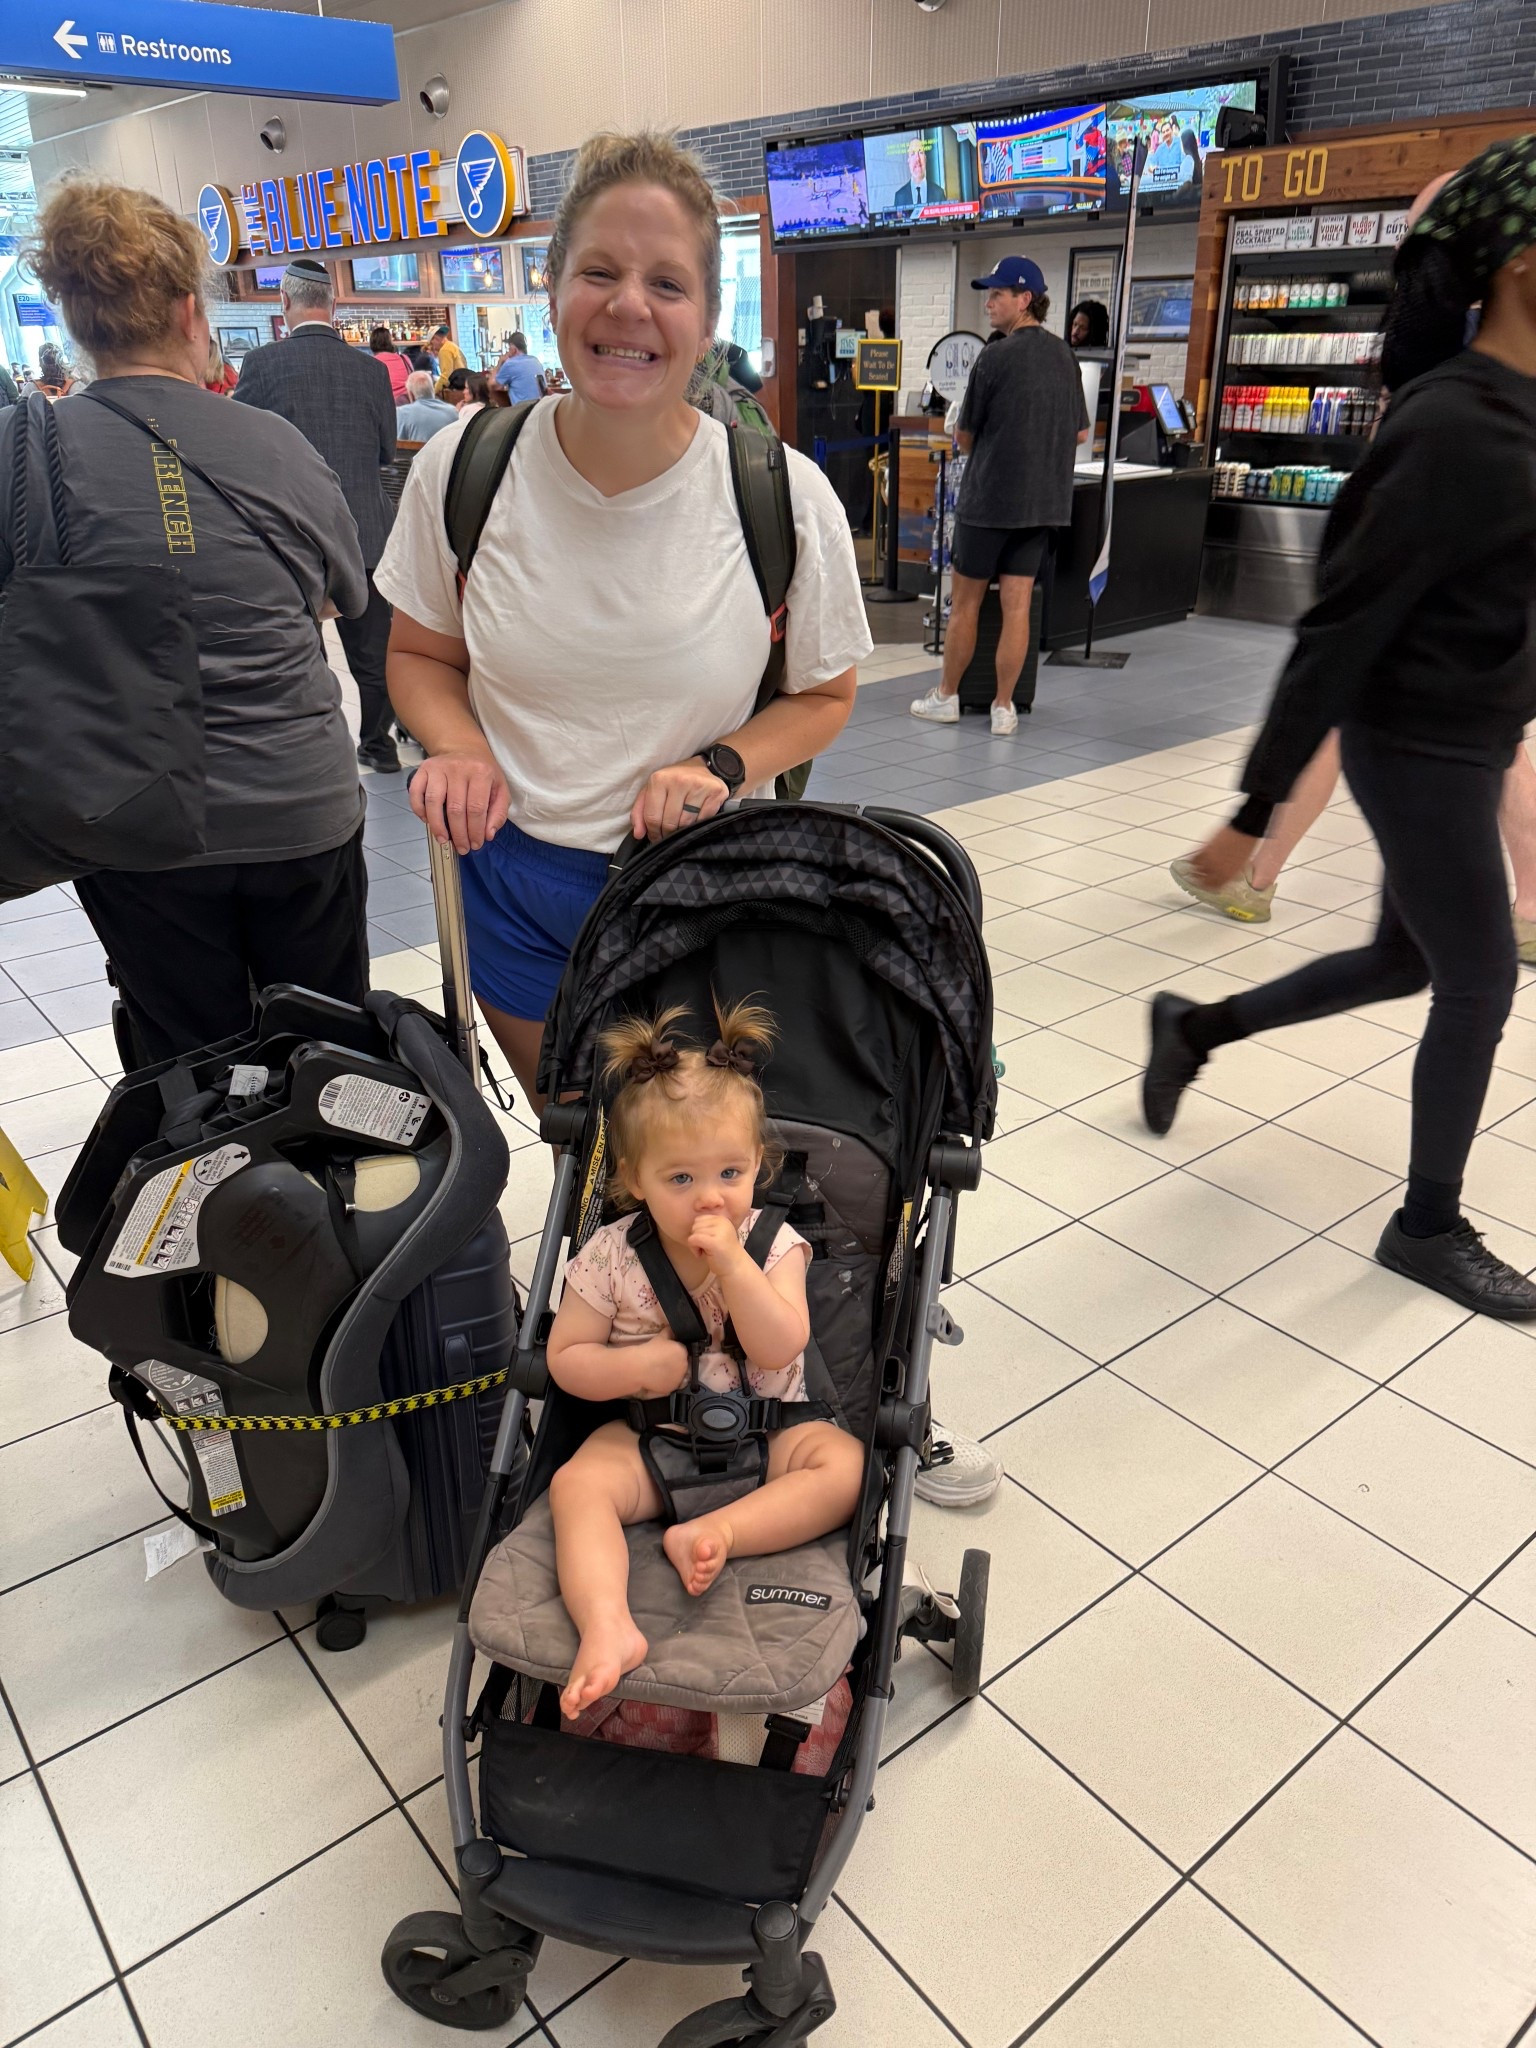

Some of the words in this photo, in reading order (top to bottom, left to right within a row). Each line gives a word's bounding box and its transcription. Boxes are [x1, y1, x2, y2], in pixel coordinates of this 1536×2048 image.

[121, 34, 232, 65] Restrooms
[1221, 154, 1264, 203] TO
[1283, 146, 1328, 198] GO
[260, 168, 346, 255] BLUE
[344, 149, 444, 246] NOTE
[241, 183, 265, 256] THE
[1236, 229, 1253, 237] REAL
[1254, 227, 1286, 236] SPIRITED
[1320, 224, 1343, 233] VODKA
[1235, 236, 1272, 245] COCKTAILS
[1321, 233, 1339, 241] MULE
[1089, 278, 1100, 287] DID
[870, 349, 889, 358] Please
[863, 361, 877, 369] Wait
[878, 360, 886, 369] To
[886, 361, 895, 369] Be
[868, 372, 889, 381] Seated
[151, 438, 196, 554] TRENCH
[589, 1154, 601, 1177] MISE
[595, 1142, 606, 1155] EN
[750, 1588, 827, 1606] summer
